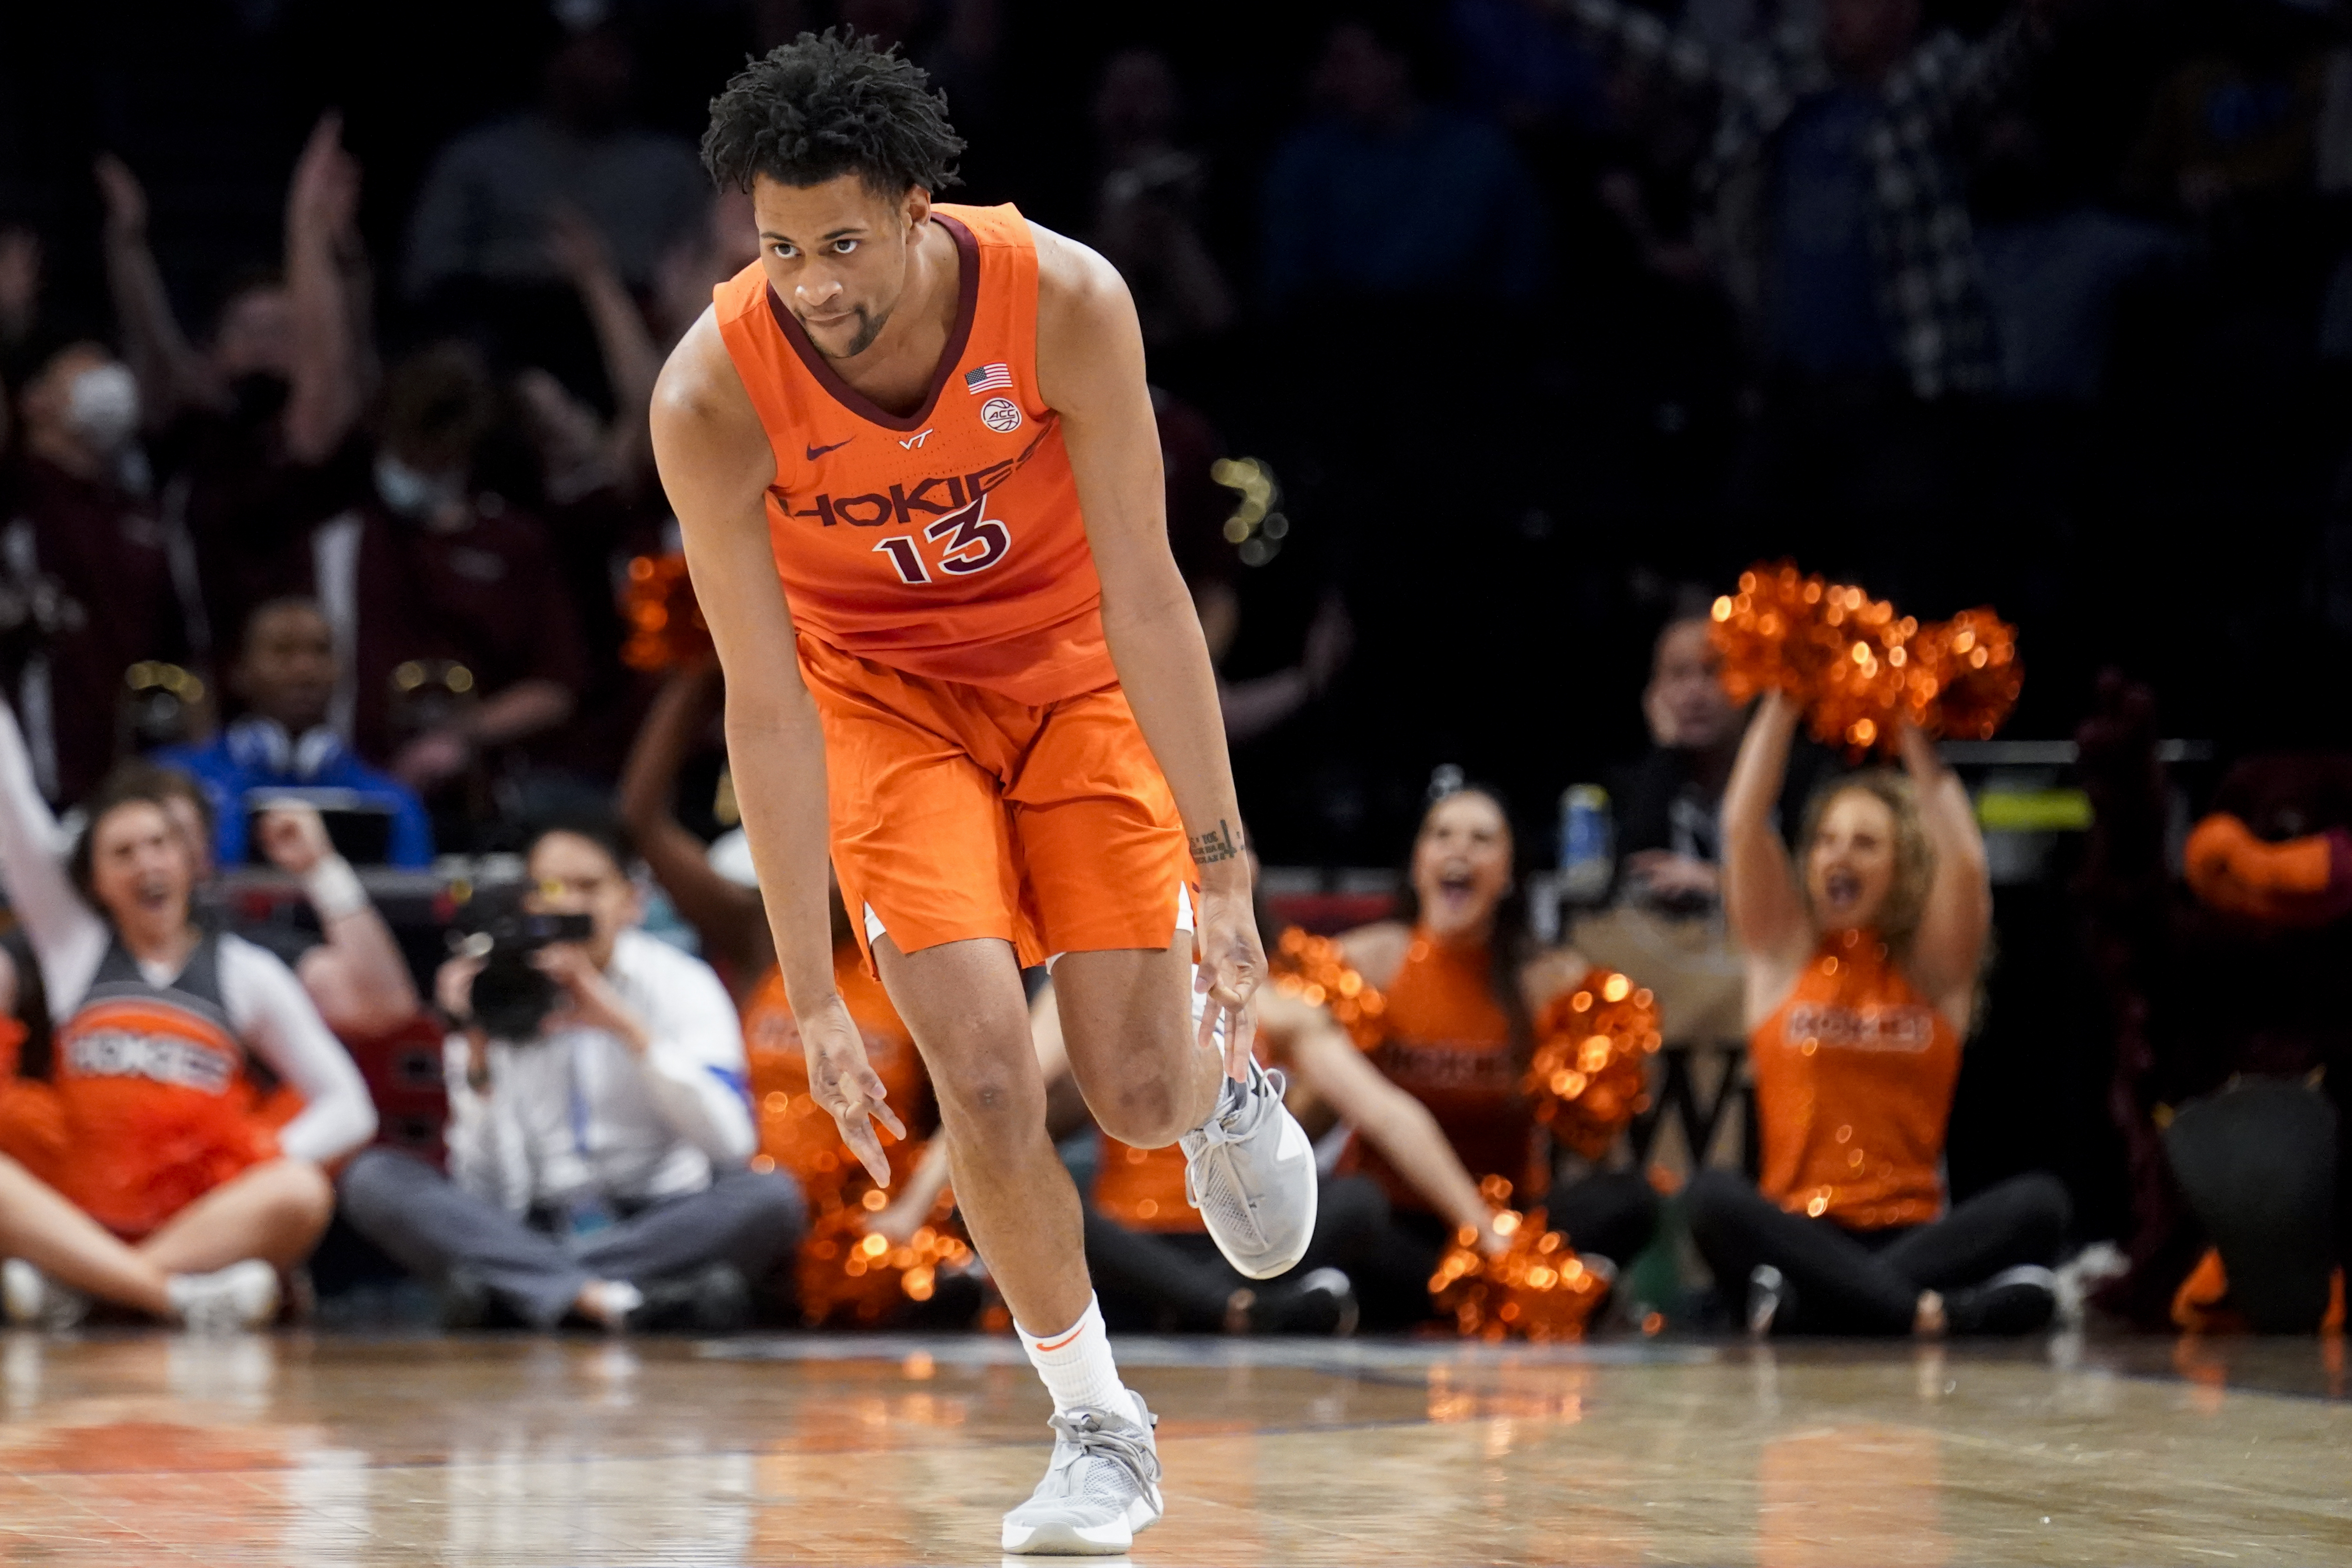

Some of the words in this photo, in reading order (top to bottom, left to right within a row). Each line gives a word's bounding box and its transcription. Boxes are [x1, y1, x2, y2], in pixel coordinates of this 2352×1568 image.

[989, 409, 1016, 419] ACC
[898, 428, 934, 450] VT
[871, 493, 1011, 584] 13
